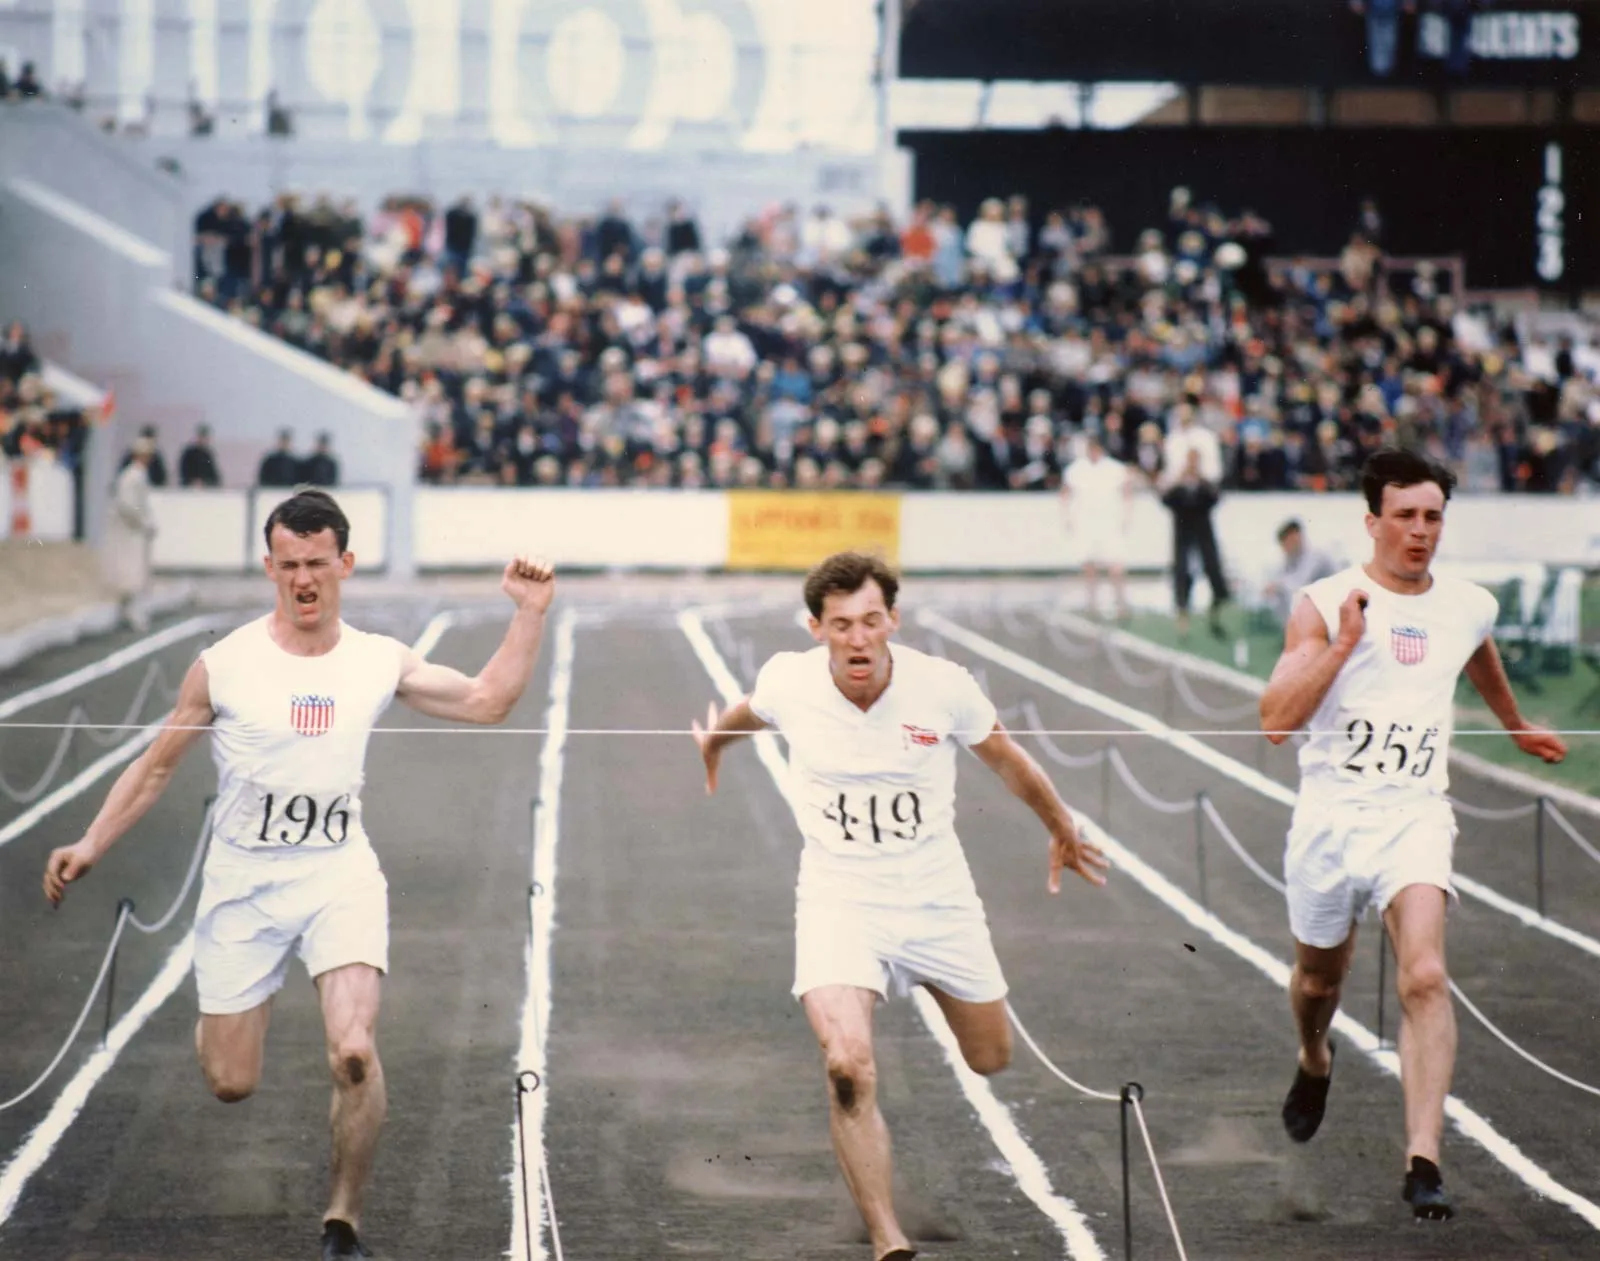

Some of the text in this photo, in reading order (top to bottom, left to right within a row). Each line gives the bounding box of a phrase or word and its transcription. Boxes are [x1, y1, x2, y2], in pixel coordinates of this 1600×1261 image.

[1341, 718, 1439, 778] 255
[257, 793, 351, 845] 196
[822, 791, 923, 843] 419
